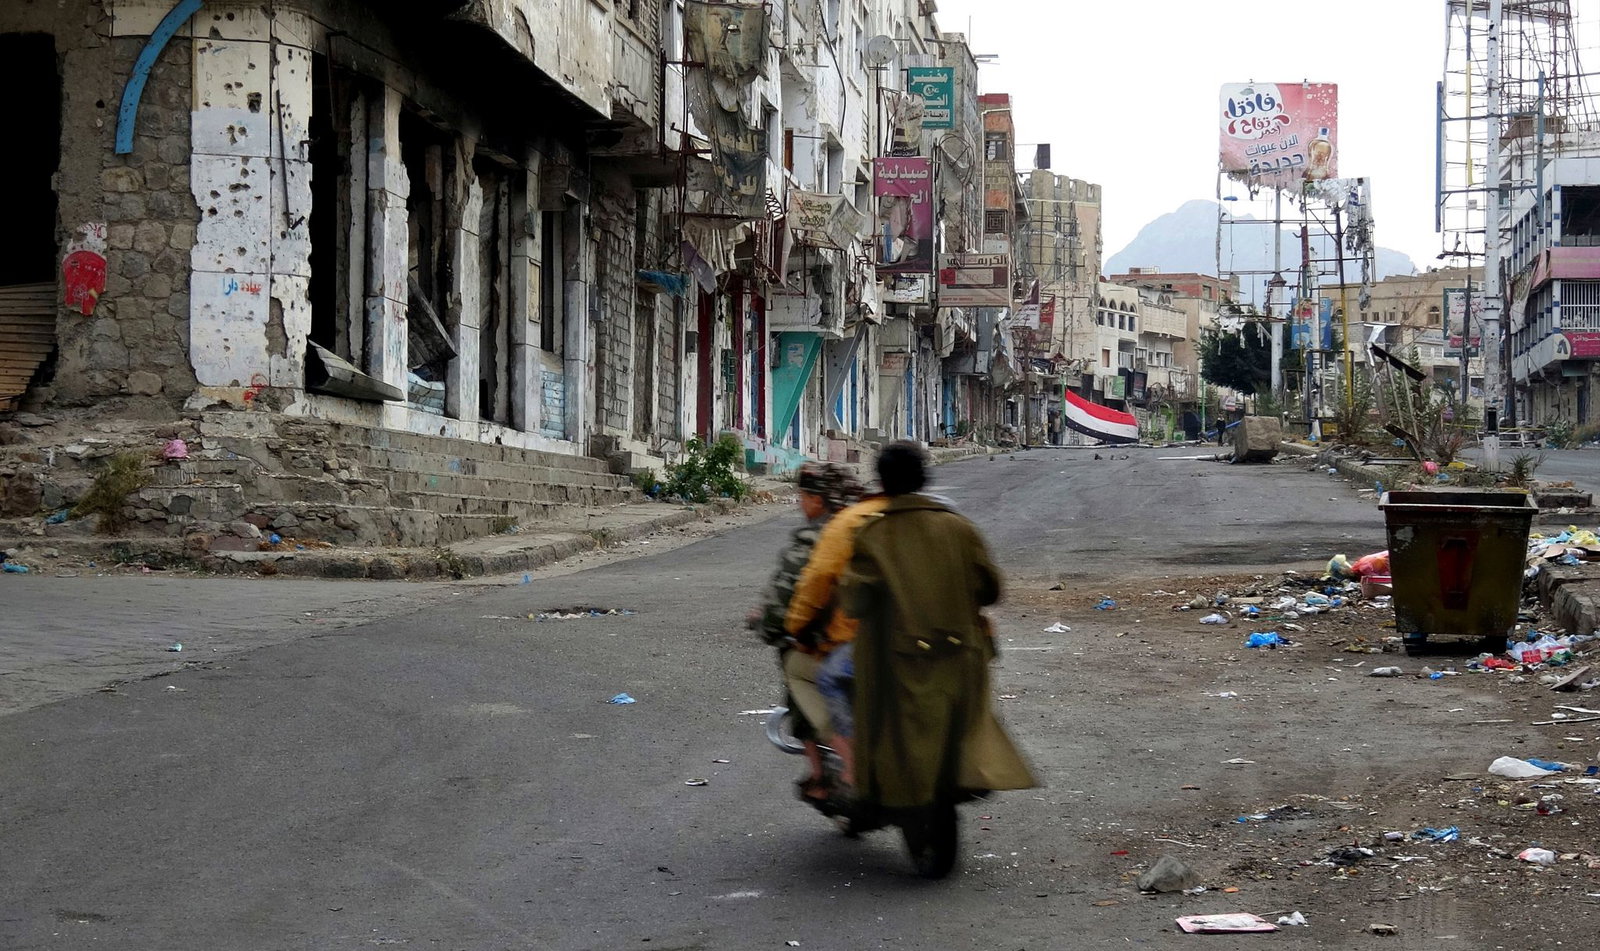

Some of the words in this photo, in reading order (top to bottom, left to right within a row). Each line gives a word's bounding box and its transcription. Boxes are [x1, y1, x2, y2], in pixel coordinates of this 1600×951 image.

[911, 69, 948, 86] مختبر
[1228, 93, 1276, 118] فانتا
[1240, 116, 1271, 134] تفاح
[1245, 142, 1277, 156] عبوات
[876, 162, 929, 184] صيدلية
